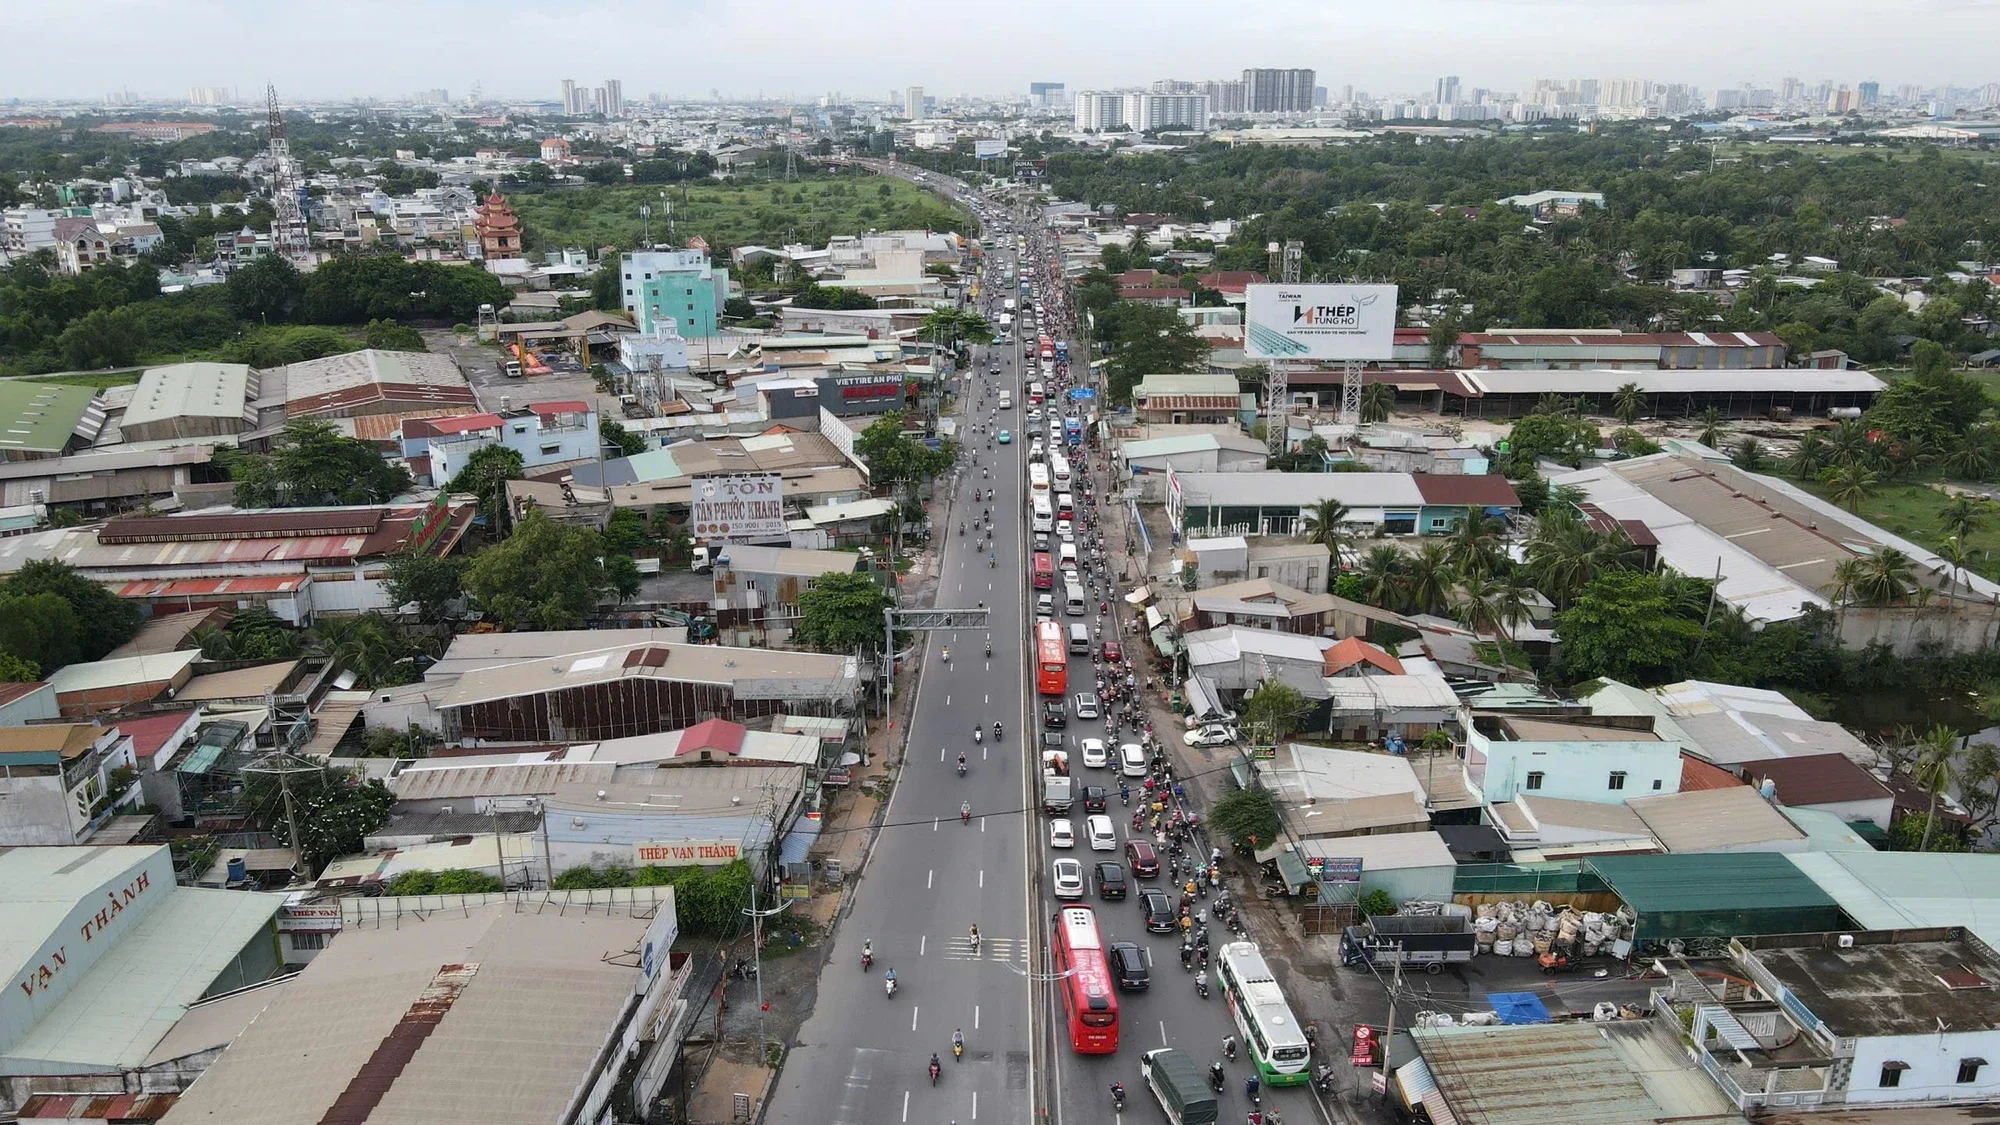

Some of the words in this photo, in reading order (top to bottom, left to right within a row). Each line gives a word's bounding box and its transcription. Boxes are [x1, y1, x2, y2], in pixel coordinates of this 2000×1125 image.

[1316, 304, 1356, 317] THÉP
[1314, 317, 1339, 325] TUNG
[1341, 317, 1355, 325] HO
[723, 478, 774, 495] TÔN
[694, 498, 712, 521] TÂN
[713, 496, 746, 520] PHƯỚC
[747, 500, 781, 520] KHANH
[639, 844, 669, 860] THÉP
[671, 846, 694, 862] VẠN
[698, 843, 736, 859] THÀNH
[20, 945, 67, 996] VẠN
[80, 870, 150, 942] THÀNH
